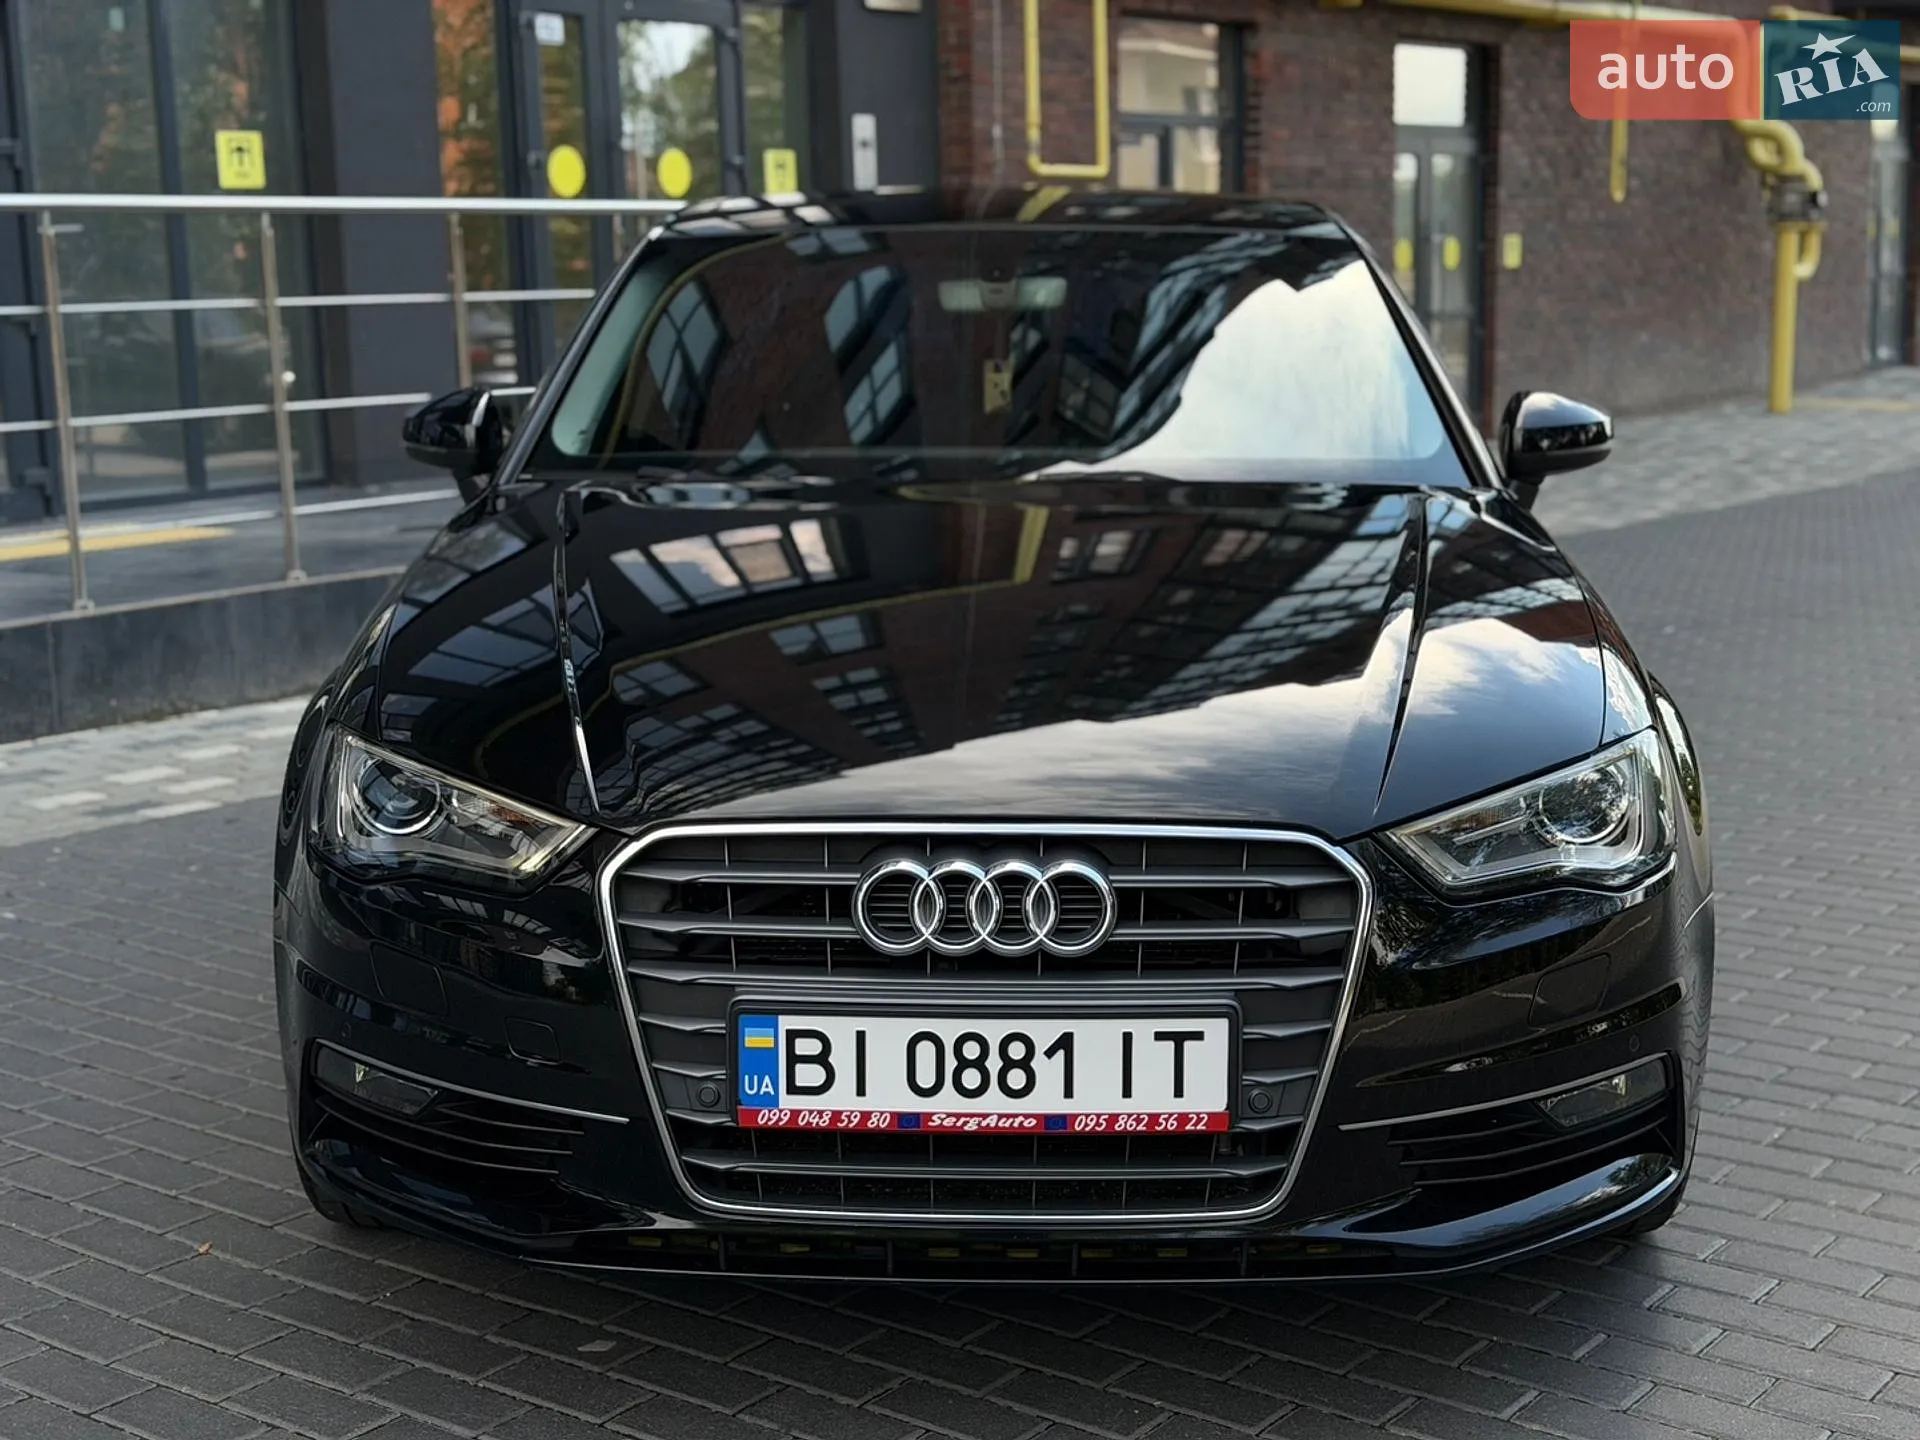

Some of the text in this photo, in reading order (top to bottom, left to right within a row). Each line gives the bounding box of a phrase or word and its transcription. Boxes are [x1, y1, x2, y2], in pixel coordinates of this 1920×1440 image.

[785, 1028, 1205, 1099] BI 0881 IT
[744, 1075, 775, 1096] UA
[757, 1109, 1208, 1131] 099 048 59 80 SergAuto 095 862 56 22
